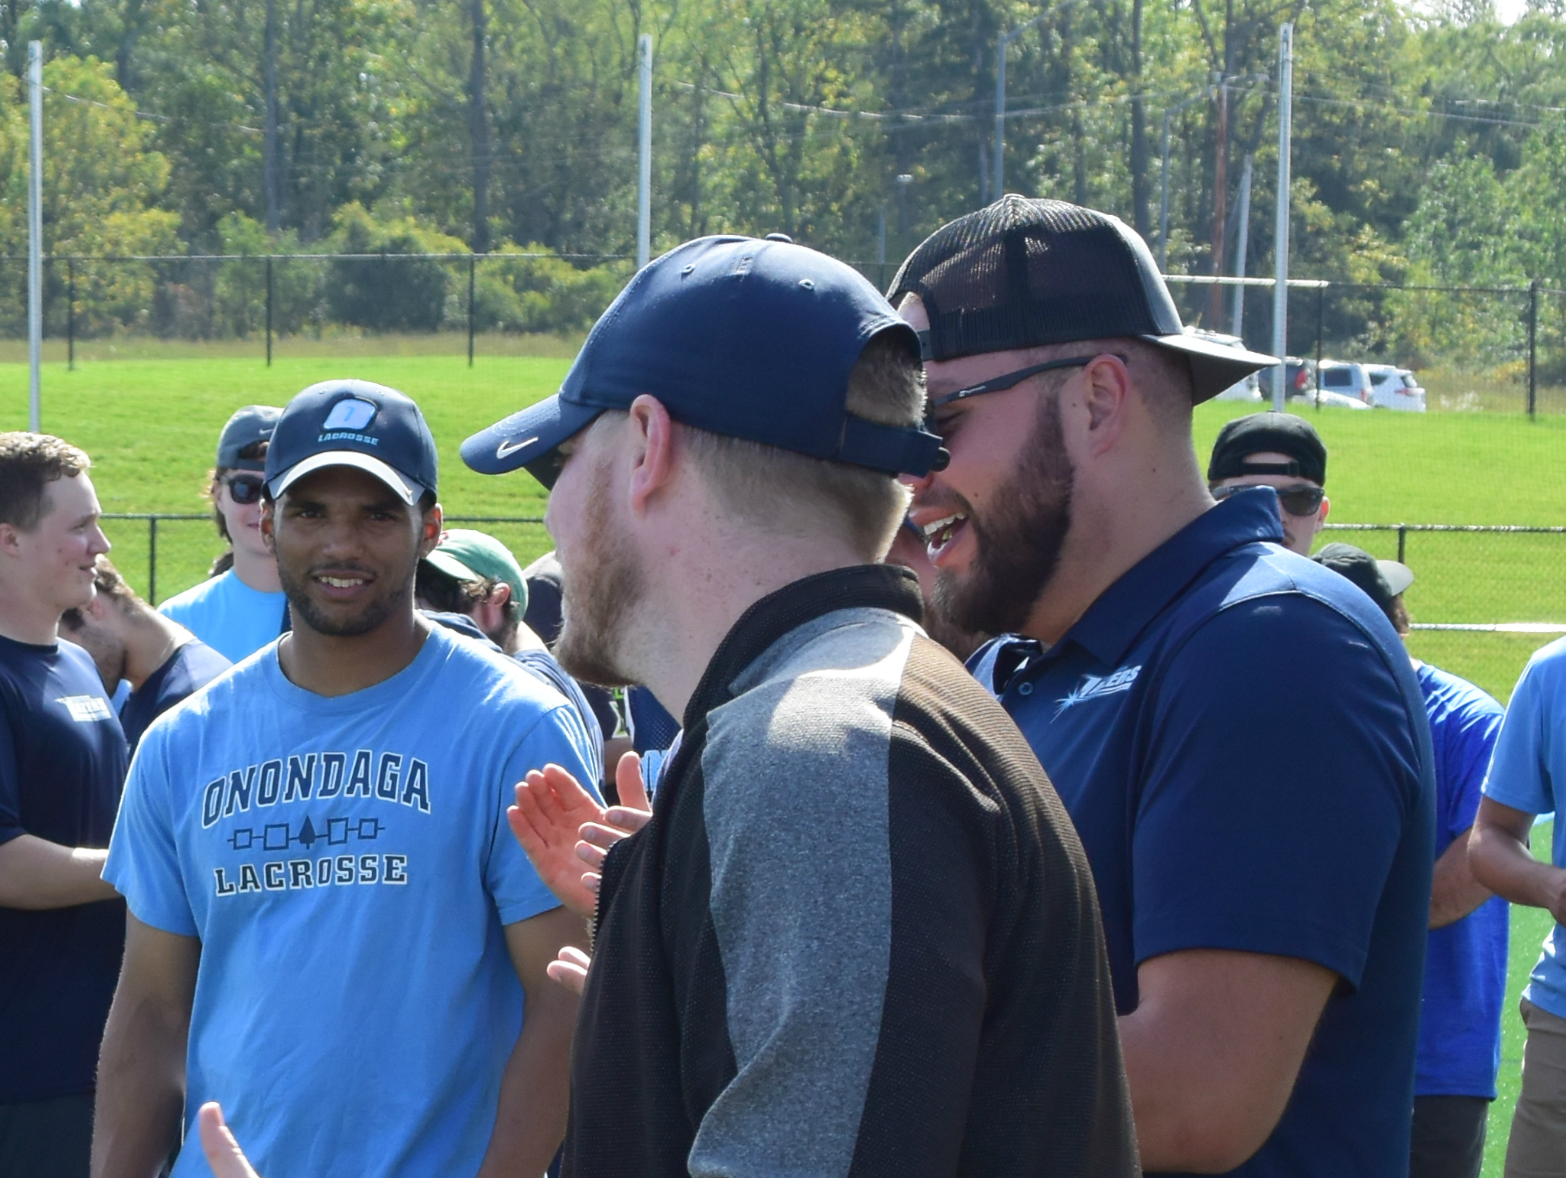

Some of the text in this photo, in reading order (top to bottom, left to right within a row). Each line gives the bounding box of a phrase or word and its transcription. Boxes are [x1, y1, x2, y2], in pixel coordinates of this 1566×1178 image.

[318, 432, 378, 446] LACROSSE
[202, 749, 432, 829] ONONDAGA
[214, 853, 408, 897] LACROSSE
